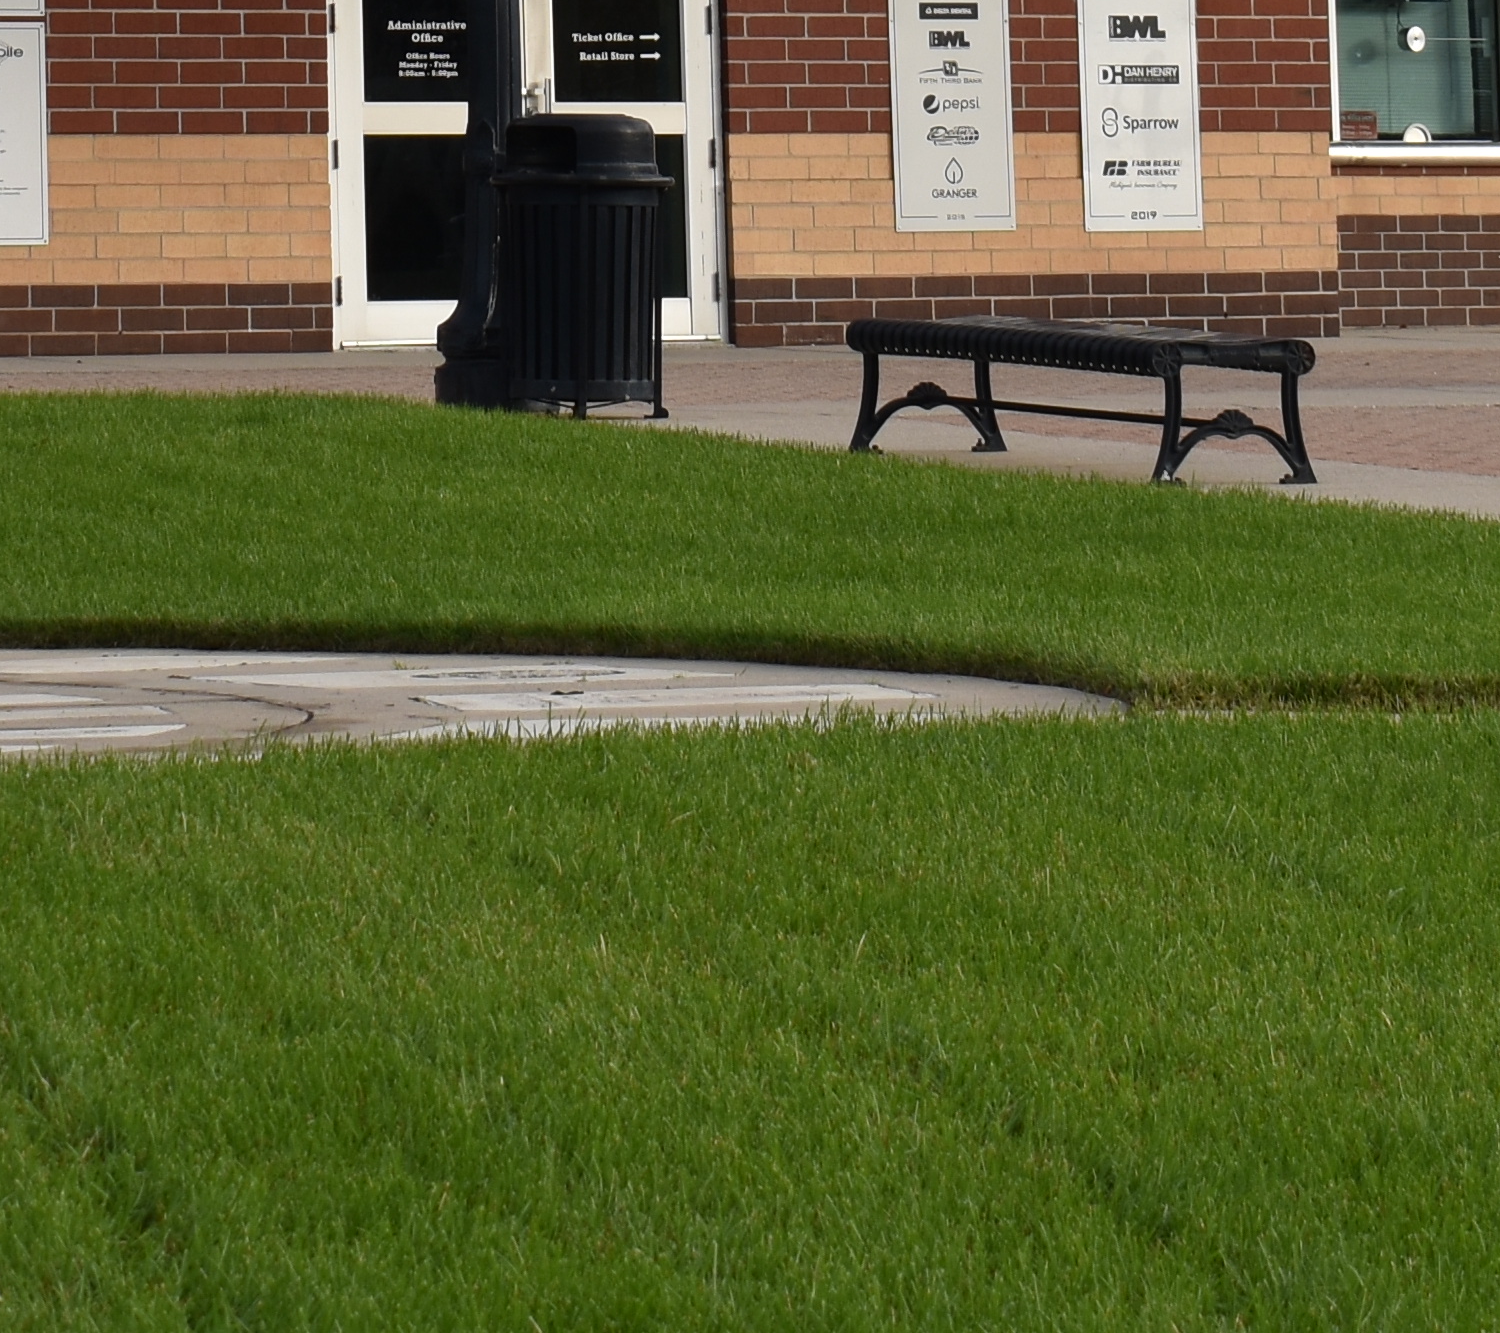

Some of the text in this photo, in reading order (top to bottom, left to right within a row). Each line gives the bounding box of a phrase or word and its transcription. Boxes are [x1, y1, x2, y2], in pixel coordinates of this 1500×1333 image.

[387, 19, 467, 30] Administrative
[1108, 15, 1167, 39] BWL
[411, 32, 444, 42] Office
[571, 32, 634, 42] Ticket Office
[928, 30, 971, 47] BWL
[579, 51, 635, 61] Retail Store
[398, 60, 428, 70] Monday
[433, 60, 458, 70] Friday
[1124, 67, 1144, 77] DAN
[1146, 67, 1178, 77] HENRY
[942, 96, 981, 113] pepsi
[1122, 115, 1179, 134] Sparrow
[931, 188, 978, 199] GRANGER
[1130, 211, 1158, 220] 2019
